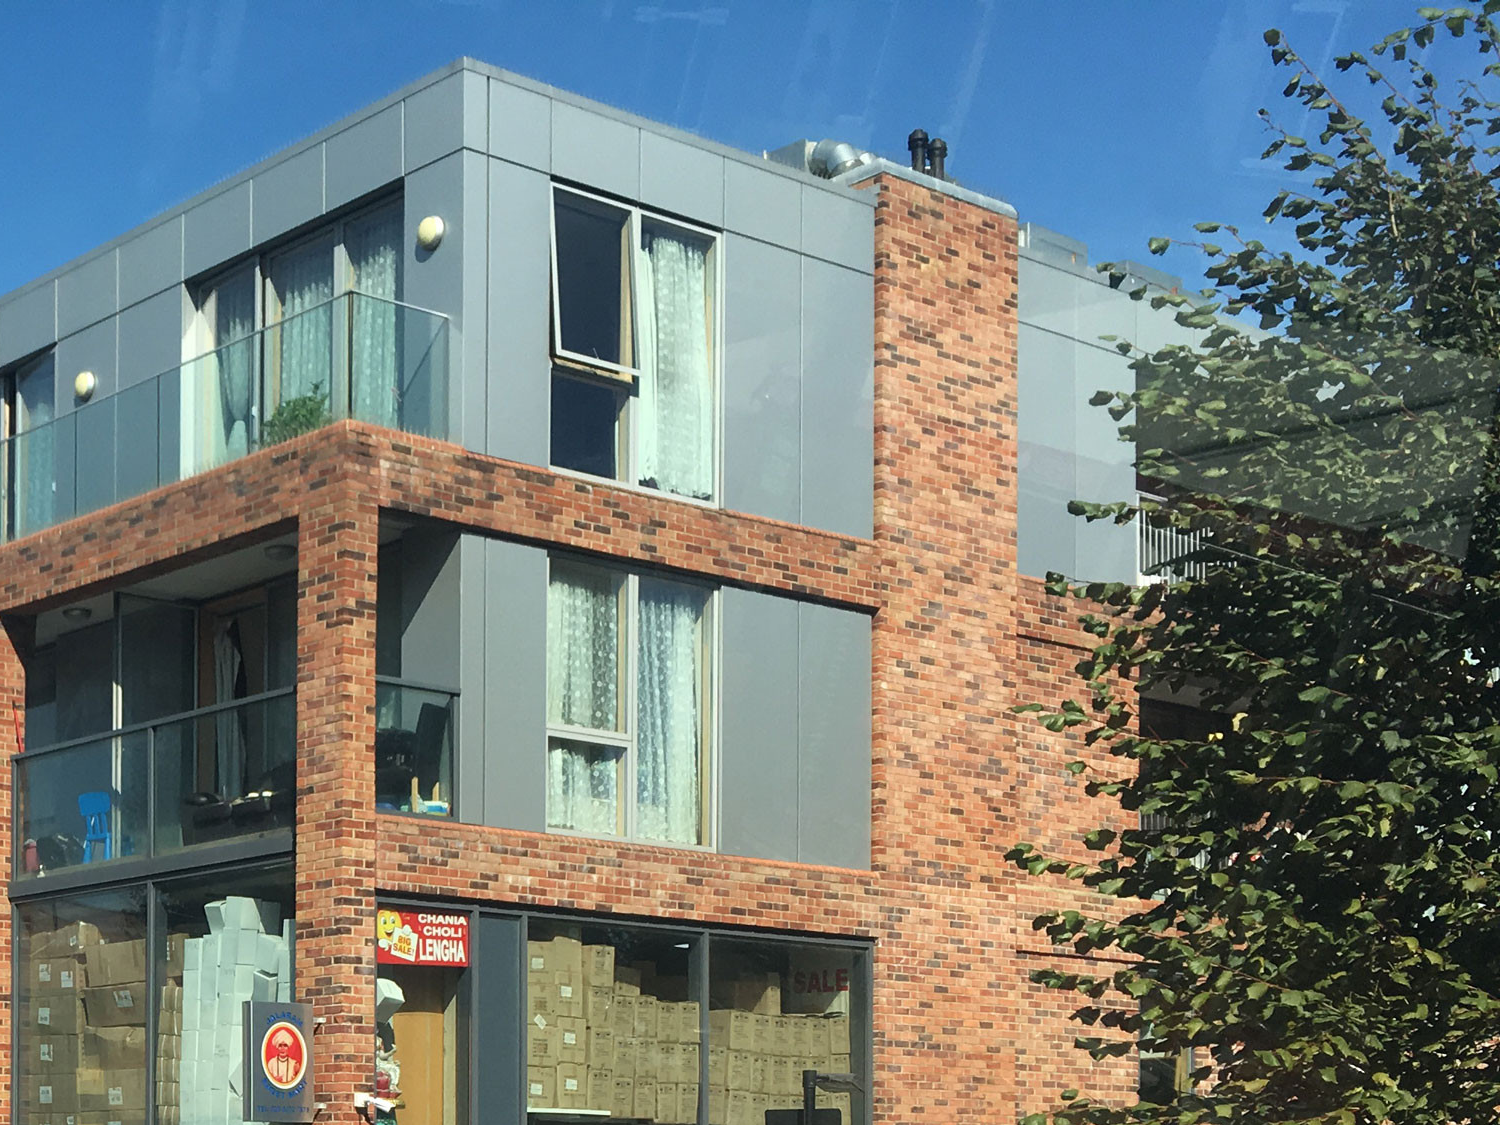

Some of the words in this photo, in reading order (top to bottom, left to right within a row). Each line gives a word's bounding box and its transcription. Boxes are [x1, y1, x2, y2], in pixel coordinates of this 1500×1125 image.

[418, 914, 467, 926] CHANIA
[423, 926, 462, 938] CHOLI
[397, 935, 412, 946] BIG
[419, 938, 466, 962] LENGHA
[794, 968, 849, 993] SALE
[266, 1011, 304, 1027] JALARAM
